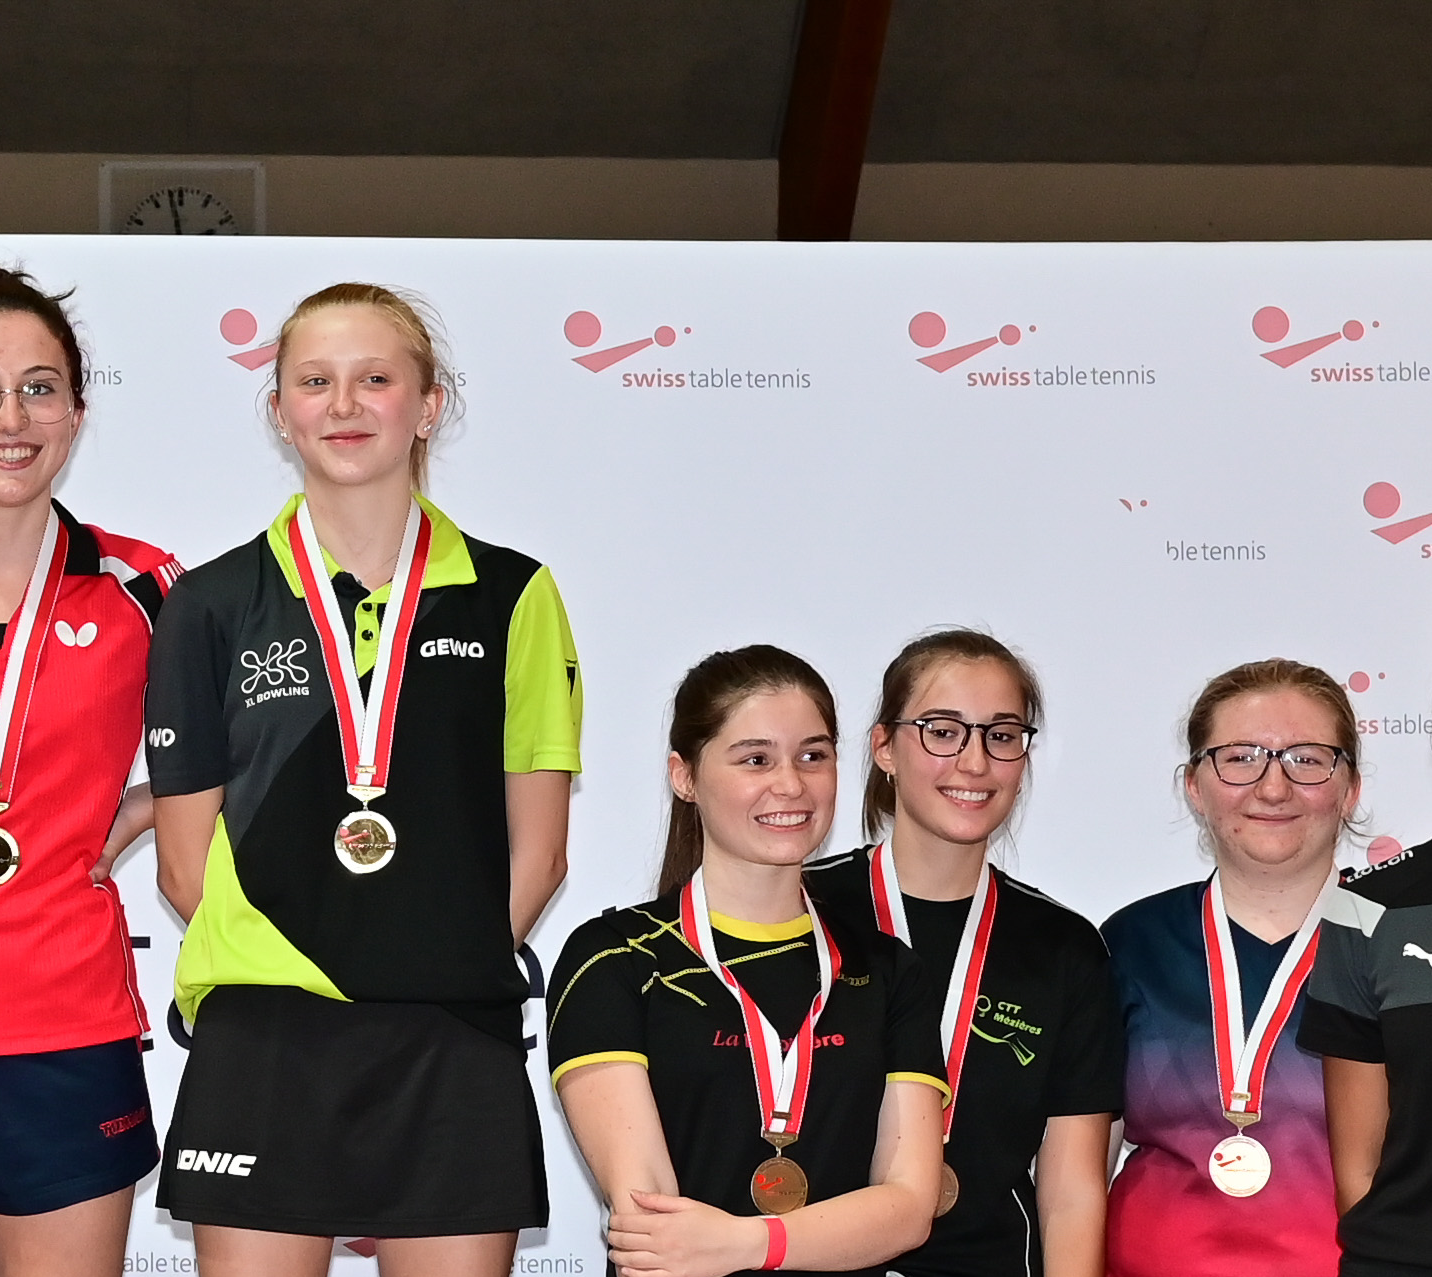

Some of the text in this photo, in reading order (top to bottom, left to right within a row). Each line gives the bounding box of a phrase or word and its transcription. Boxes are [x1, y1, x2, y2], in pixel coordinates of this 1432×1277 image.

[1310, 362, 1374, 383] swiss
[419, 638, 485, 658] GEWO
[257, 687, 310, 704] BOWLING
[997, 1001, 1022, 1014] CTT
[177, 1149, 257, 1177] ONIC
